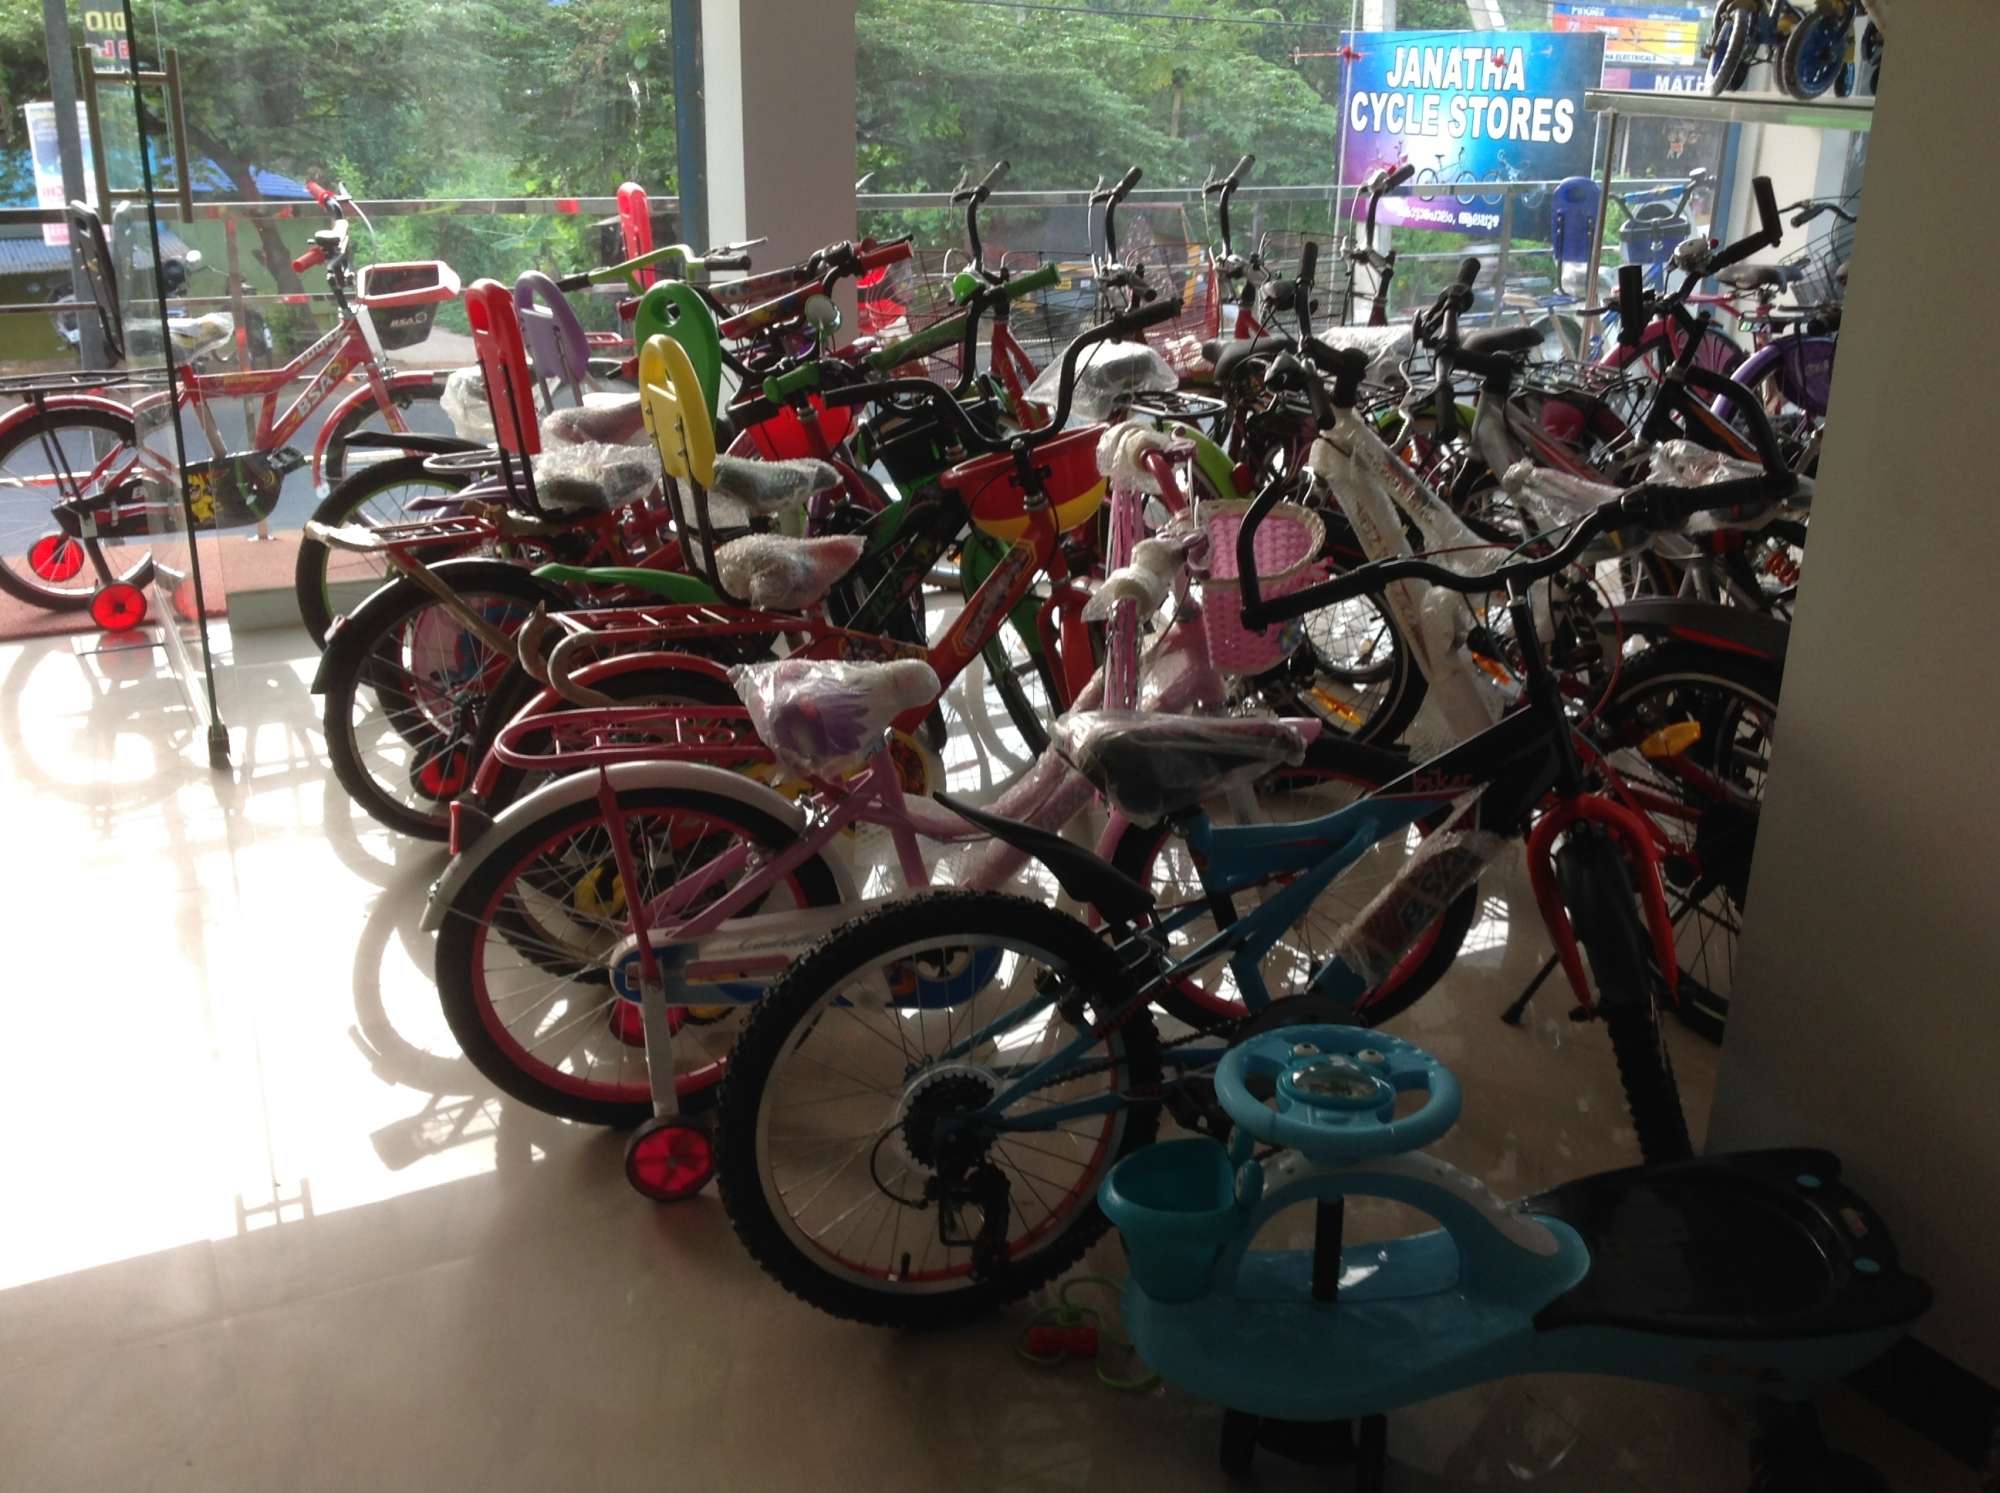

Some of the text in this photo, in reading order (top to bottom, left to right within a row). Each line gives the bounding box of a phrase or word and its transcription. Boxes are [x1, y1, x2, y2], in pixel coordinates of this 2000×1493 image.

[1386, 46, 1526, 92] JANATHA
[1350, 91, 1576, 145] CYCLE STORES
[297, 376, 335, 417] BSA
